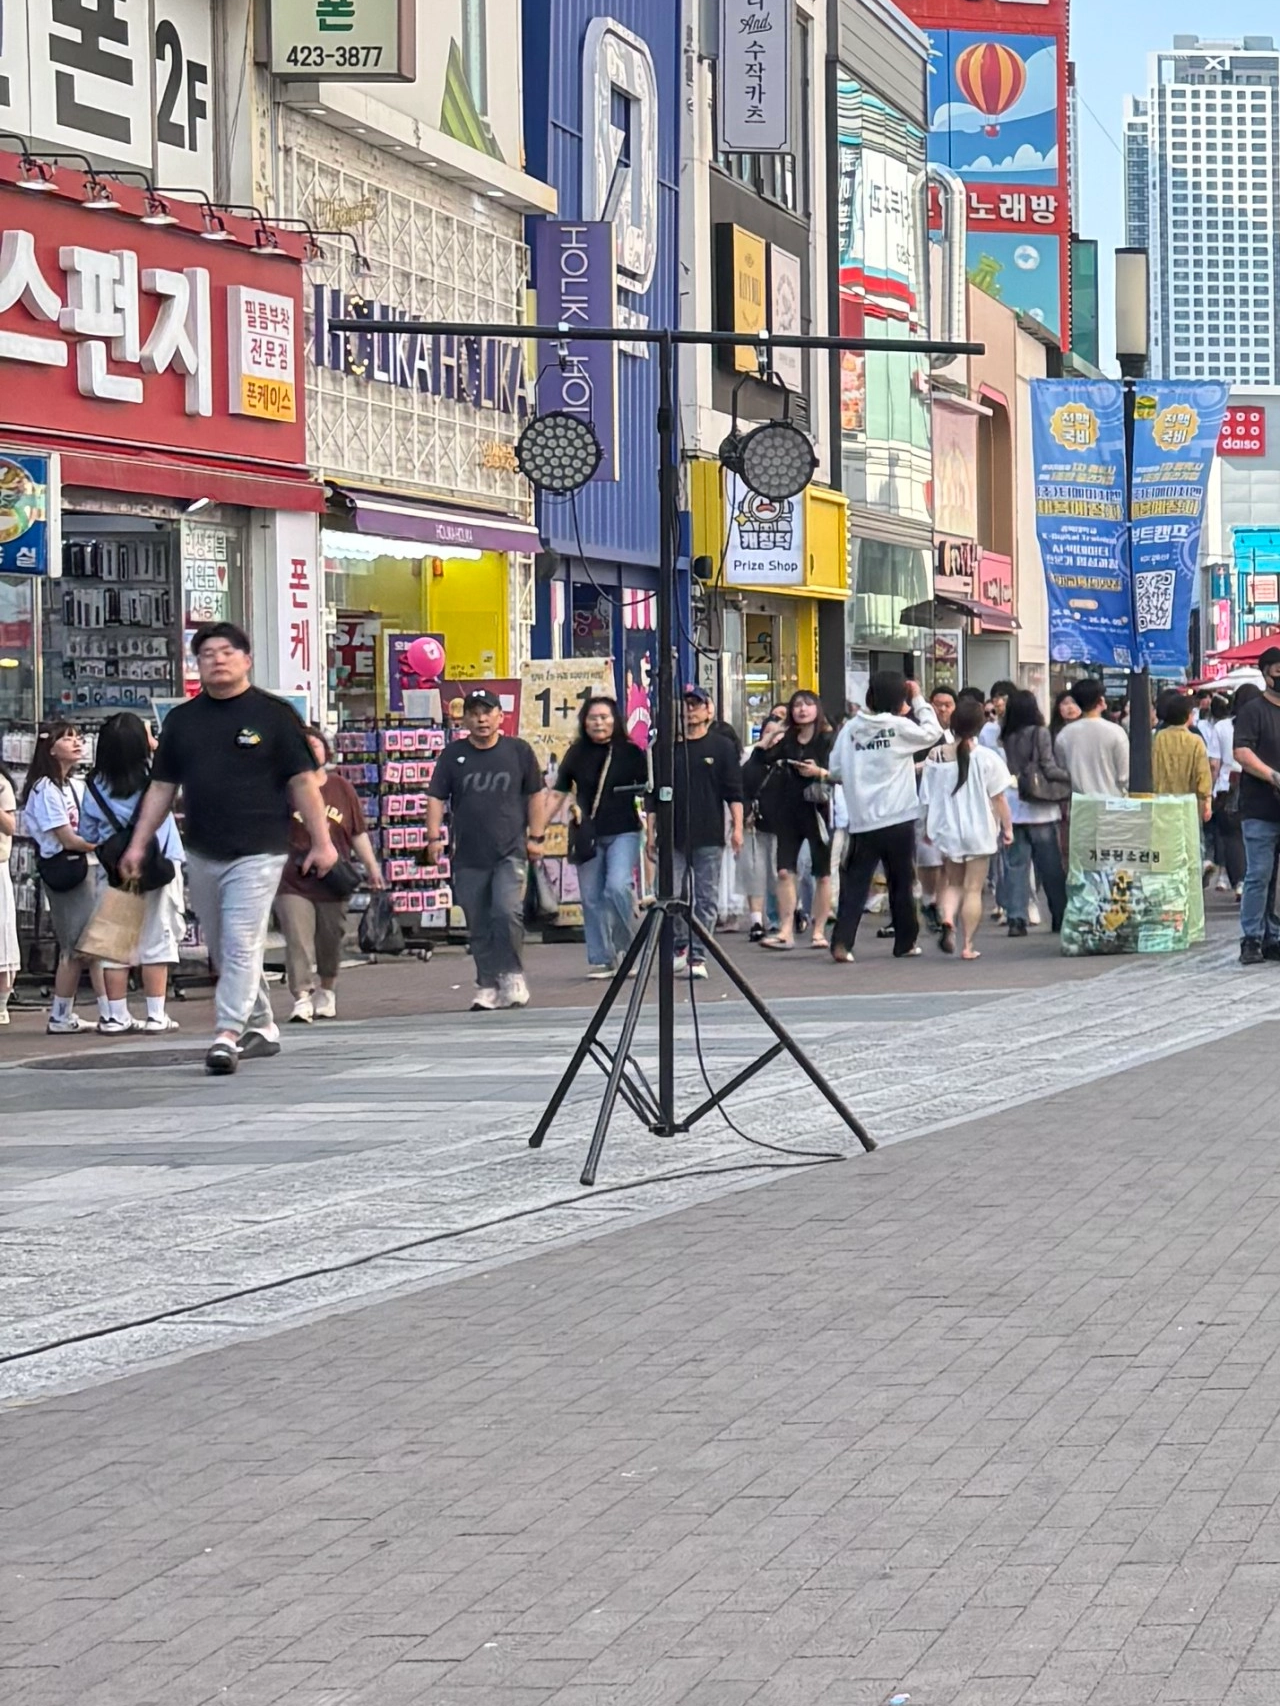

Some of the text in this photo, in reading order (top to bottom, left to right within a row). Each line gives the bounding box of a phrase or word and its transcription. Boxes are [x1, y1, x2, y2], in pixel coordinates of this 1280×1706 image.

[286, 45, 384, 68] 423-3877
[156, 19, 208, 153] 2F
[744, 39, 767, 125] 수작카츠
[969, 192, 1060, 226] 노래방
[0, 229, 213, 417] 스펀지
[246, 380, 292, 414] 폰케이스
[1222, 436, 1261, 451] daiso
[733, 559, 799, 573] Prize Shop
[289, 558, 311, 691] 폰케
